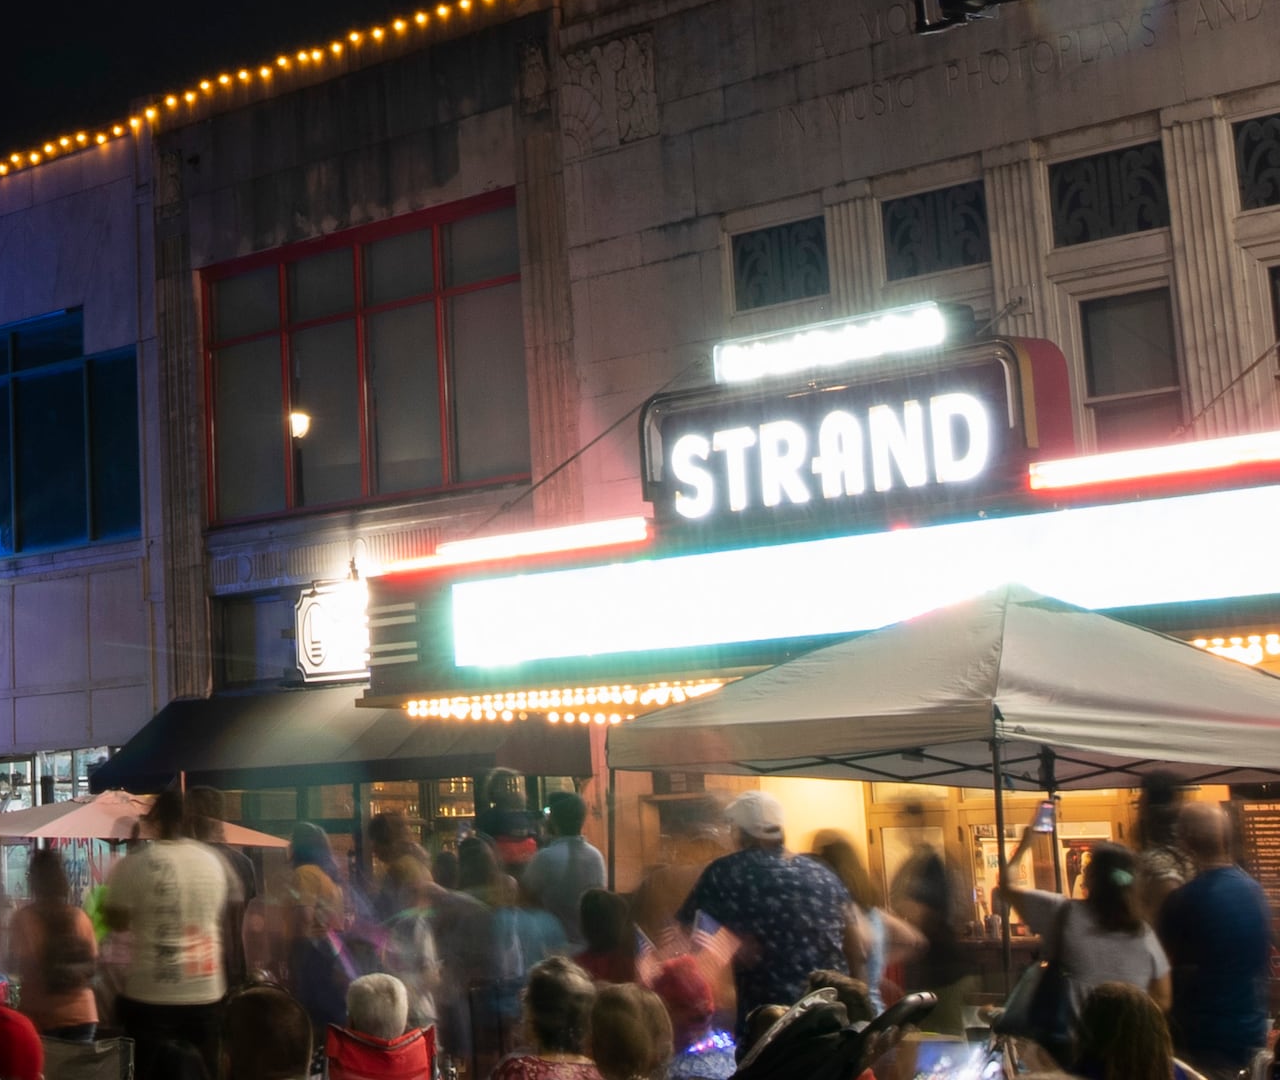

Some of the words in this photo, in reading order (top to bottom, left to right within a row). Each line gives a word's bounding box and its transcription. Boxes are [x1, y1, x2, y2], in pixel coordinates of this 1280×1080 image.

[824, 76, 916, 136] MUSIC
[944, 12, 1157, 98] PHOTOPLAYS
[671, 392, 990, 520] STRAND
